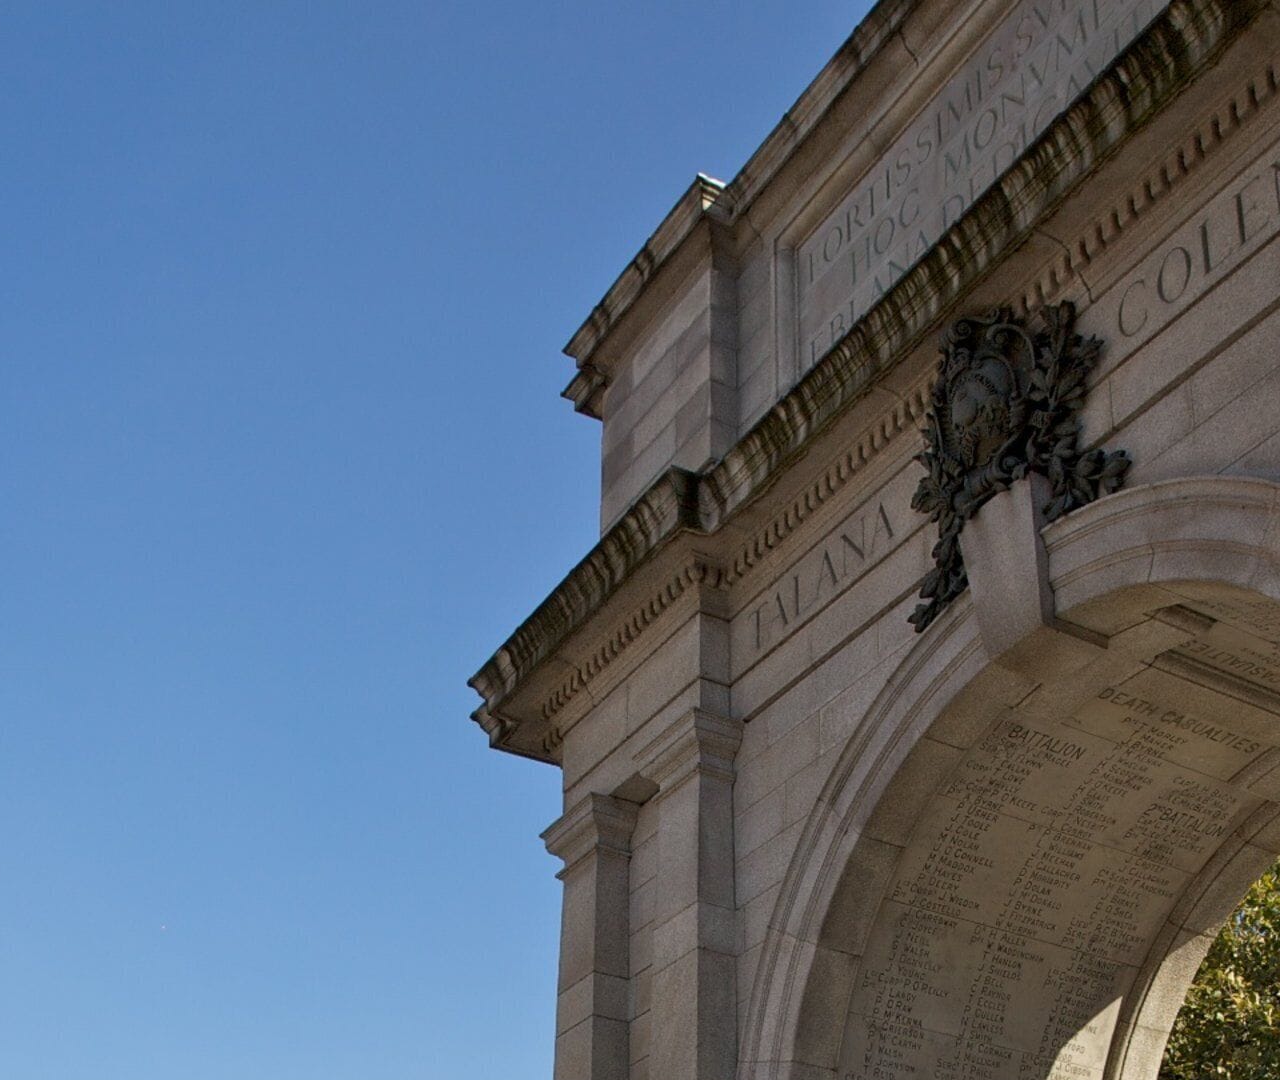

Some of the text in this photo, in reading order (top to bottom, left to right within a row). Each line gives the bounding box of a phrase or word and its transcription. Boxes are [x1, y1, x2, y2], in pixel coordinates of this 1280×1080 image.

[808, 50, 1004, 285] FORTISSIMIS
[851, 188, 920, 287] HOC
[748, 500, 896, 649] TALANA
[1097, 688, 1261, 755] DEATH CASUALTIES
[1006, 723, 1088, 760] BATTALION
[966, 803, 1003, 822] USHER
[960, 815, 992, 832] TOOLE
[1157, 807, 1227, 838] BATTALION
[949, 833, 983, 852] NOLAN
[932, 865, 964, 882] HAYES
[937, 855, 977, 874] MADDOX
[1023, 879, 1053, 896] DOLAN
[918, 896, 963, 917] COSTELLO
[1012, 900, 1044, 917] BYRNE
[998, 931, 1027, 947] ALLEN
[902, 941, 932, 959] WALSH
[987, 963, 1023, 982] SHIELDS
[874, 1055, 916, 1073] JOHNSON
